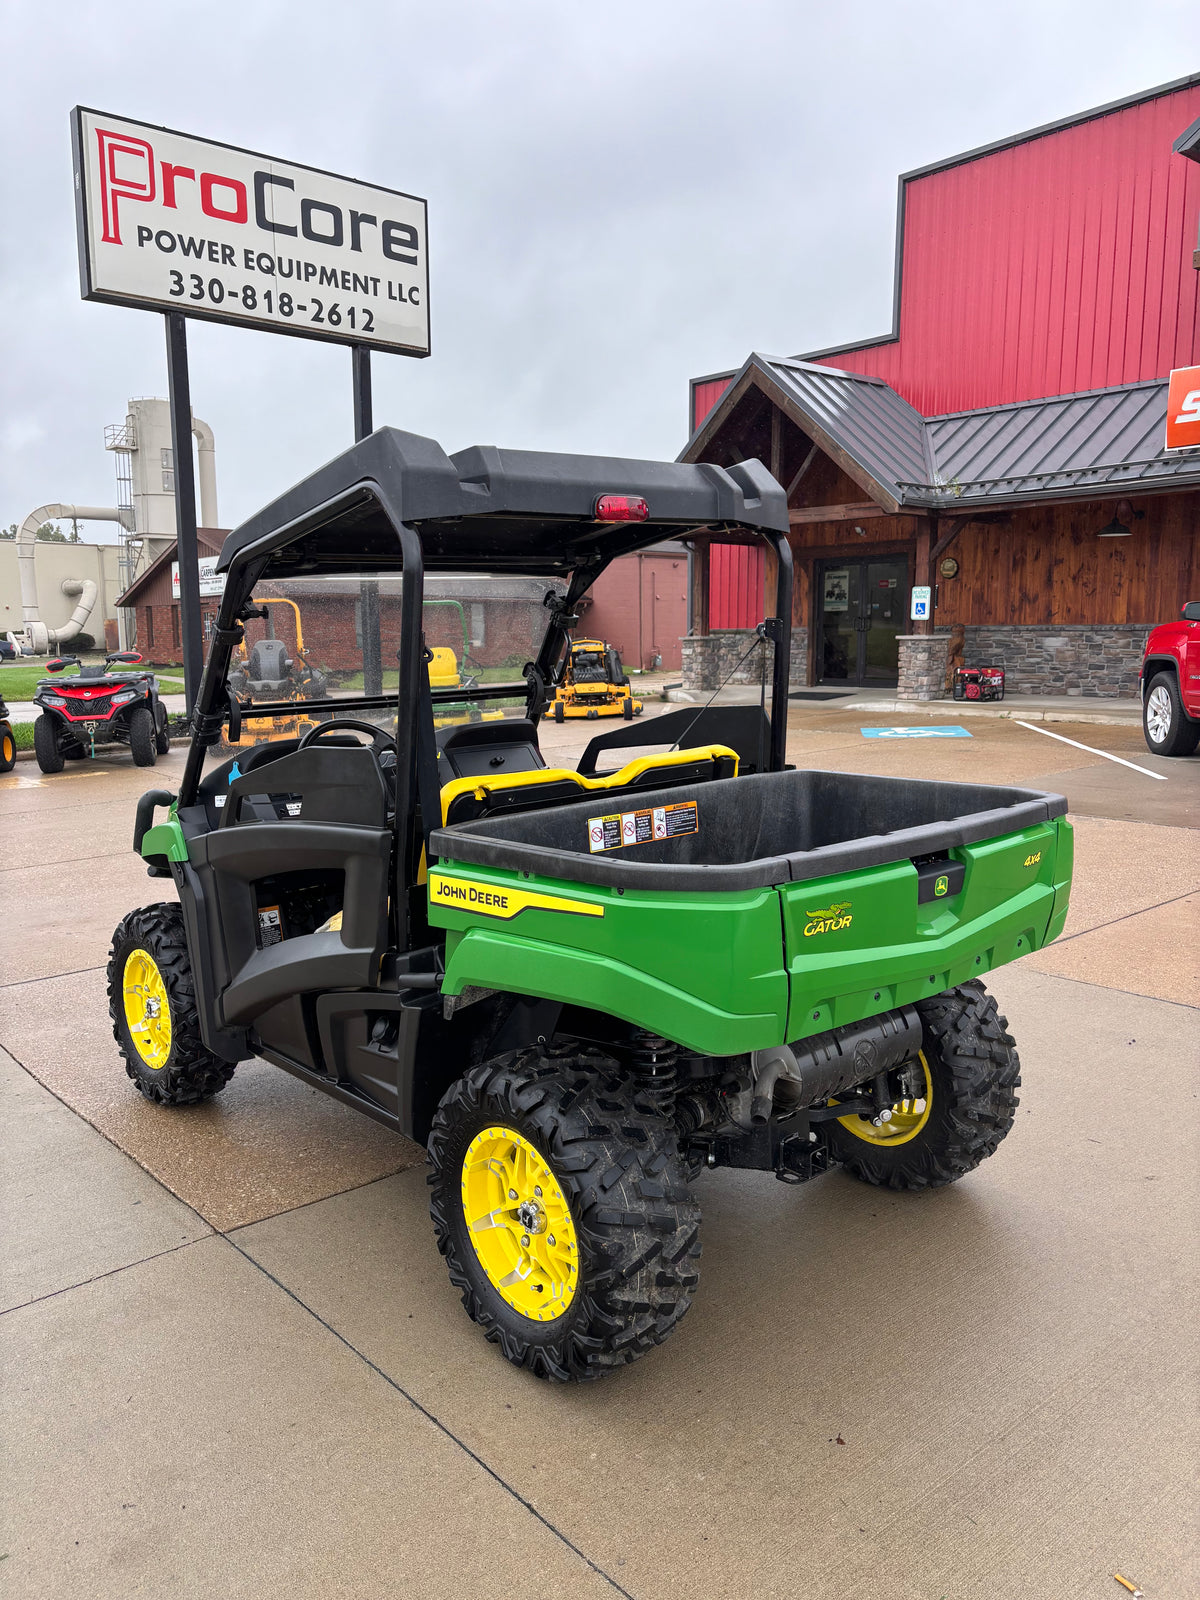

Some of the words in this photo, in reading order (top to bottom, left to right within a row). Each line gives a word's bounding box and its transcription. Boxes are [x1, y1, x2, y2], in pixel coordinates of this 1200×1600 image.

[95, 127, 419, 266] ProCore
[137, 225, 237, 267] POWER
[244, 249, 381, 296] EQUIPMENT
[387, 281, 420, 306] LLC
[169, 270, 375, 333] 330-818-2612
[201, 568, 216, 577] CARPEN
[803, 914, 853, 938] GATOR
